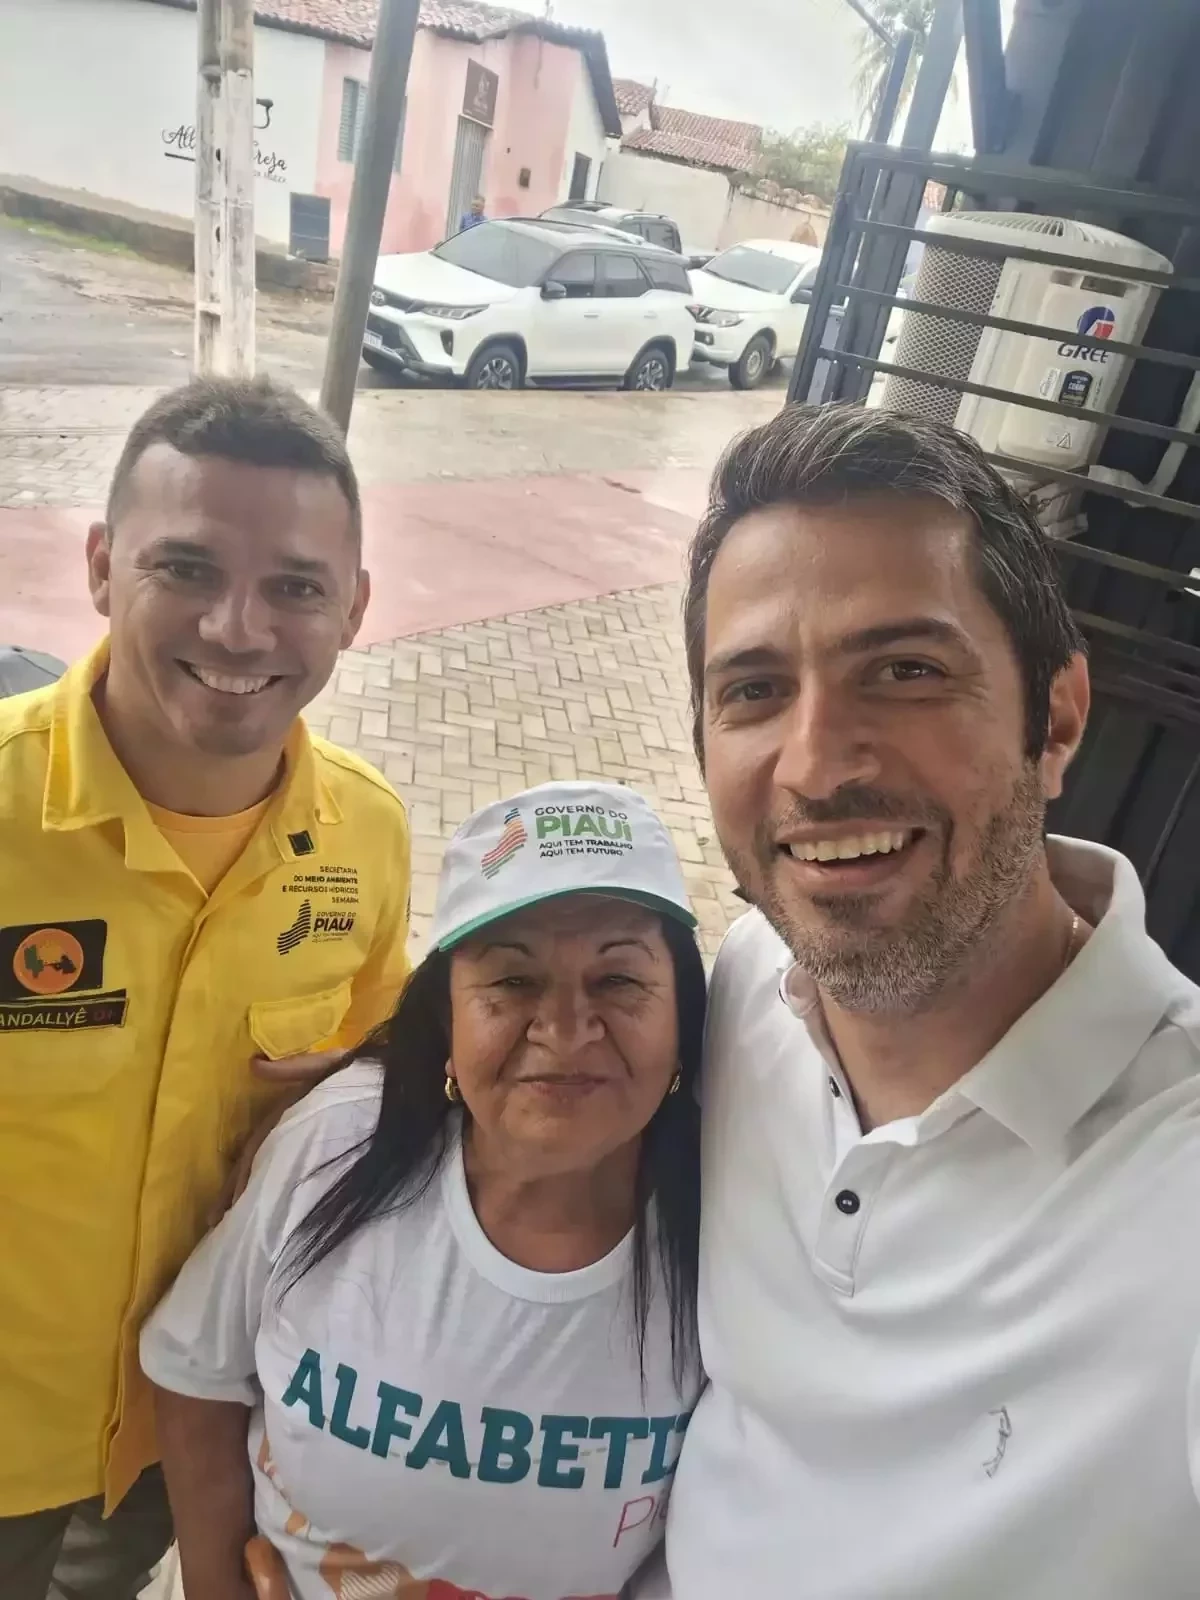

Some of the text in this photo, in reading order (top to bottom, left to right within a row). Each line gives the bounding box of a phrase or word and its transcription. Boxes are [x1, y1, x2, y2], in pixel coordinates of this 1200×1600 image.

[1057, 341, 1109, 364] GREE
[534, 804, 628, 820] GOVERNO DO
[539, 840, 562, 850] AQUI
[540, 848, 564, 858] AQUI
[566, 847, 585, 855] TEM
[320, 866, 357, 874] SECRETARIA
[282, 885, 287, 893] E
[288, 885, 328, 893] RECURSOS
